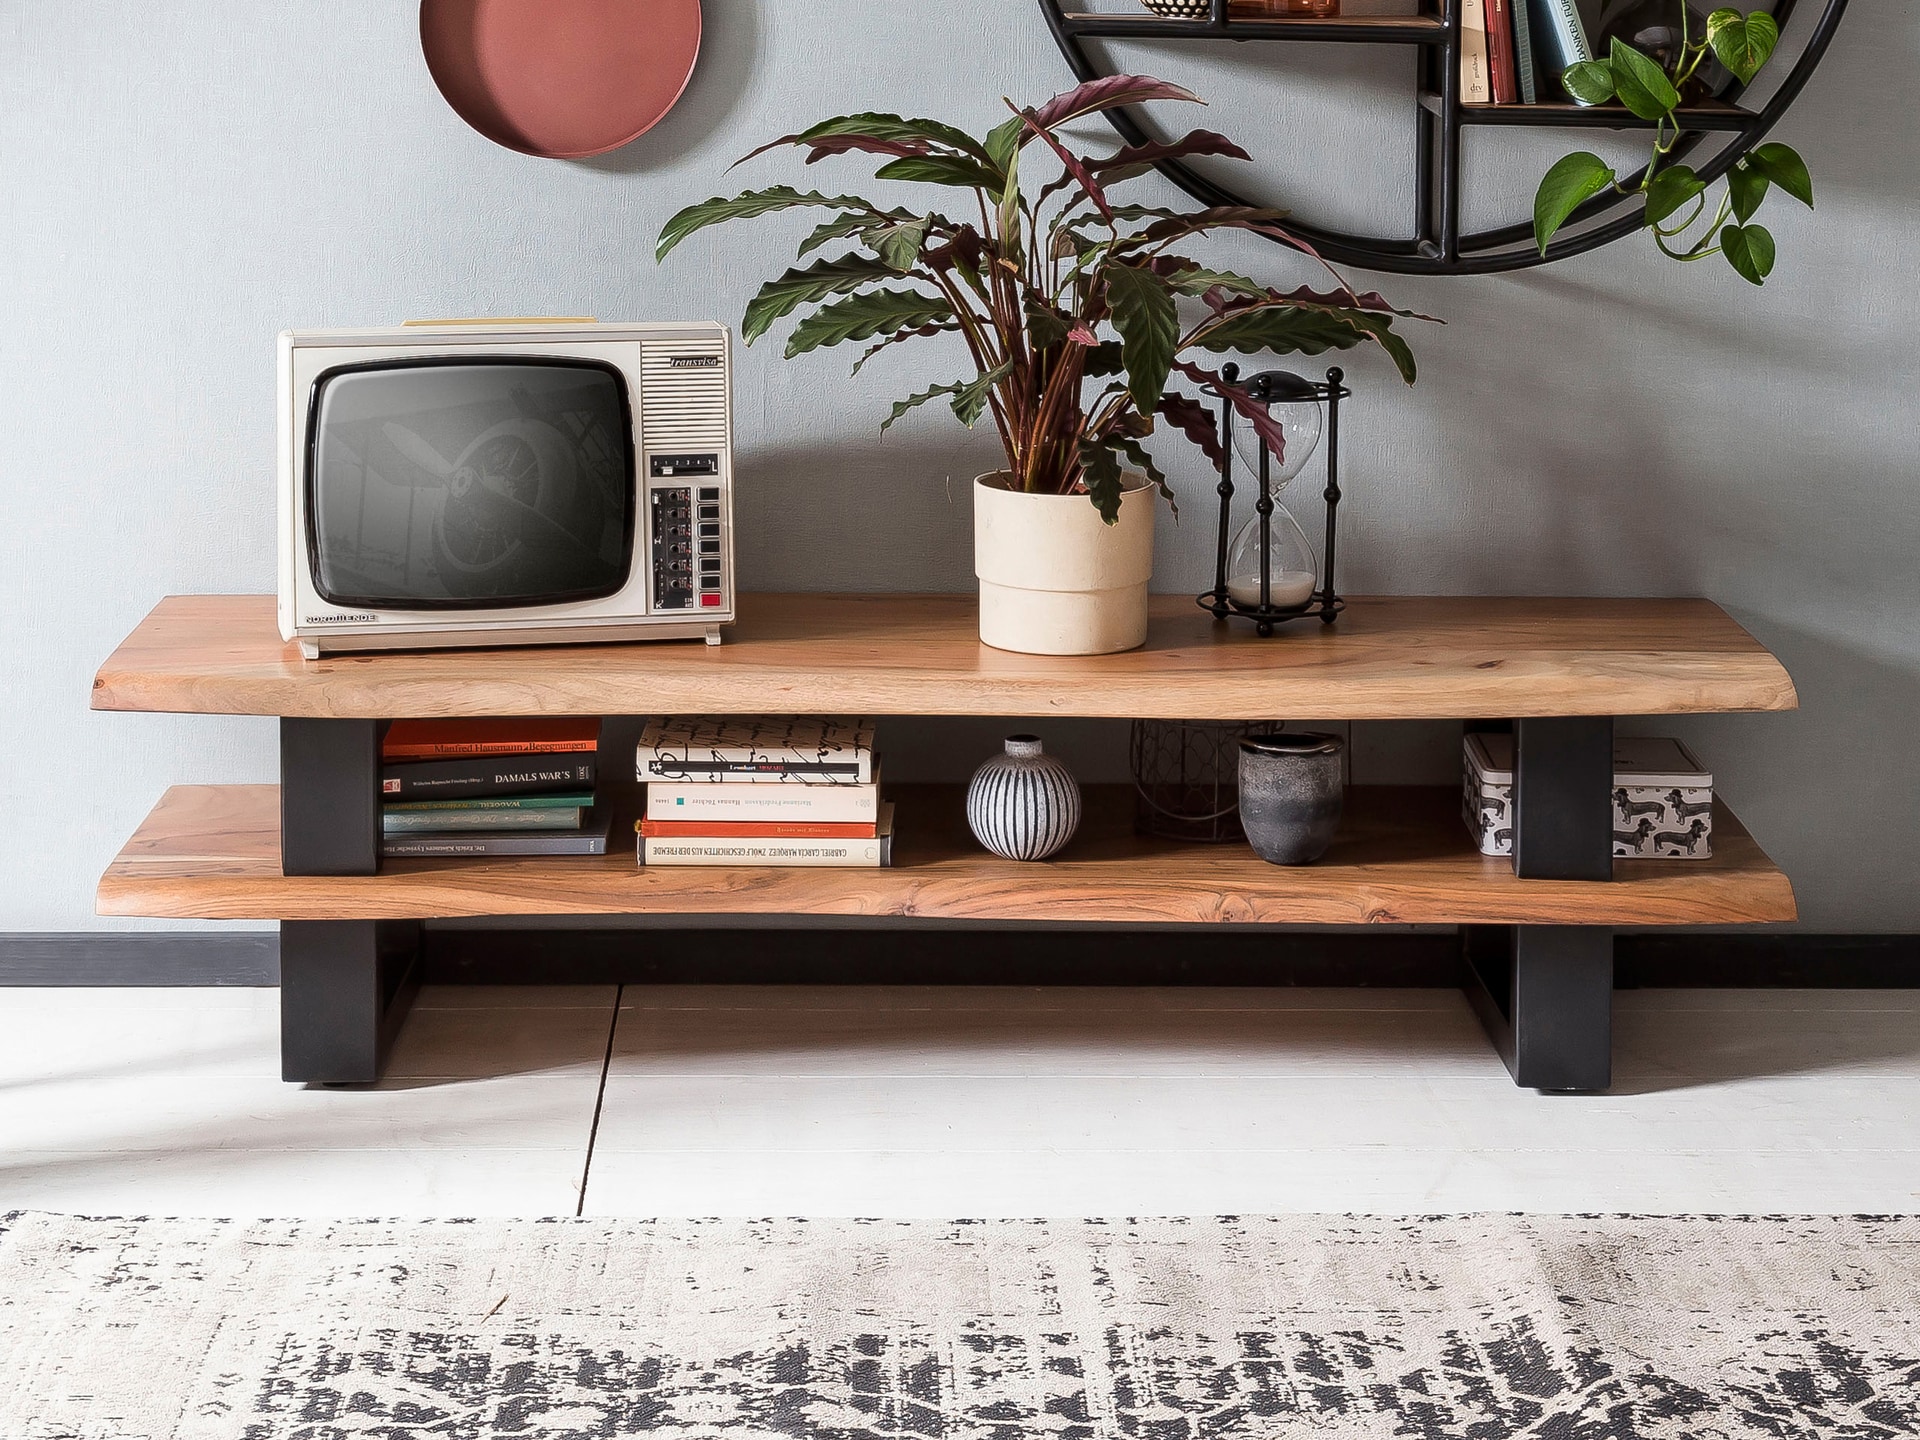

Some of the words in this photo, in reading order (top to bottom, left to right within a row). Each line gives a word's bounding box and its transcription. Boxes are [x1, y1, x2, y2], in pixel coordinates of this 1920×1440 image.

[1568, 20, 1587, 62] DANKEN
[1470, 83, 1483, 94] dtv
[434, 743, 473, 753] Manfred
[475, 742, 523, 752] Hausmann
[528, 741, 587, 751] Begegnungen
[495, 773, 537, 784] DAMALS
[538, 770, 571, 781] WAR'S
[396, 844, 425, 853] Lyrische
[455, 844, 474, 852] Erich
[653, 846, 678, 856] FREMDE
[678, 847, 690, 856] DER
[691, 847, 703, 856] AUS
[703, 847, 745, 857] GESCHICHTEN
[746, 847, 767, 857] ZWÖLF
[820, 848, 847, 858] GABRIEL
